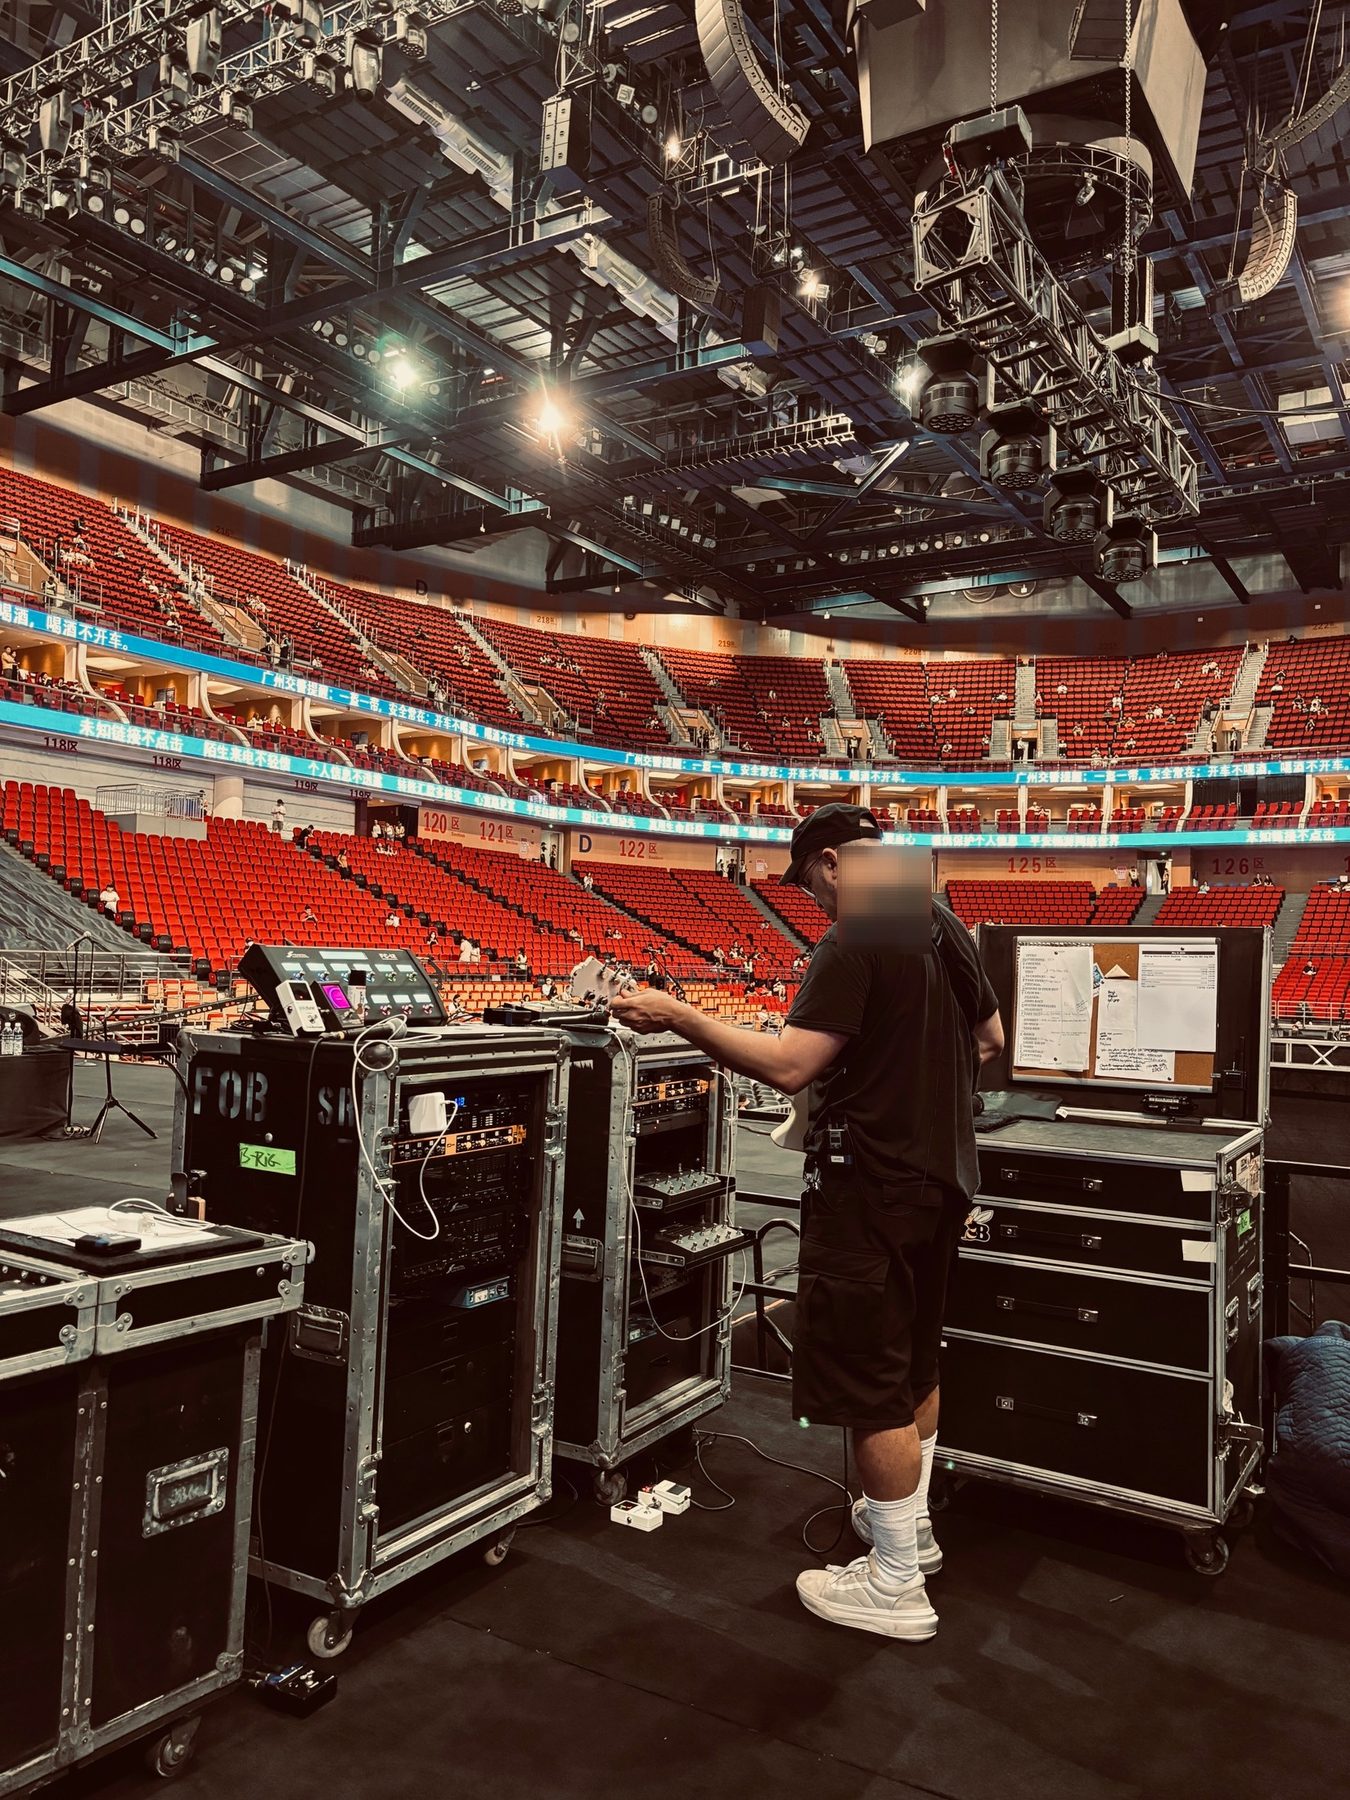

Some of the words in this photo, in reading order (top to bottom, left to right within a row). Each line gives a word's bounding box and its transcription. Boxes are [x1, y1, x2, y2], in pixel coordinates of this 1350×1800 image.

[43, 737, 78, 752] 118区
[152, 756, 182, 769] 118区
[578, 834, 593, 853] D
[193, 1066, 269, 1122] FOB
